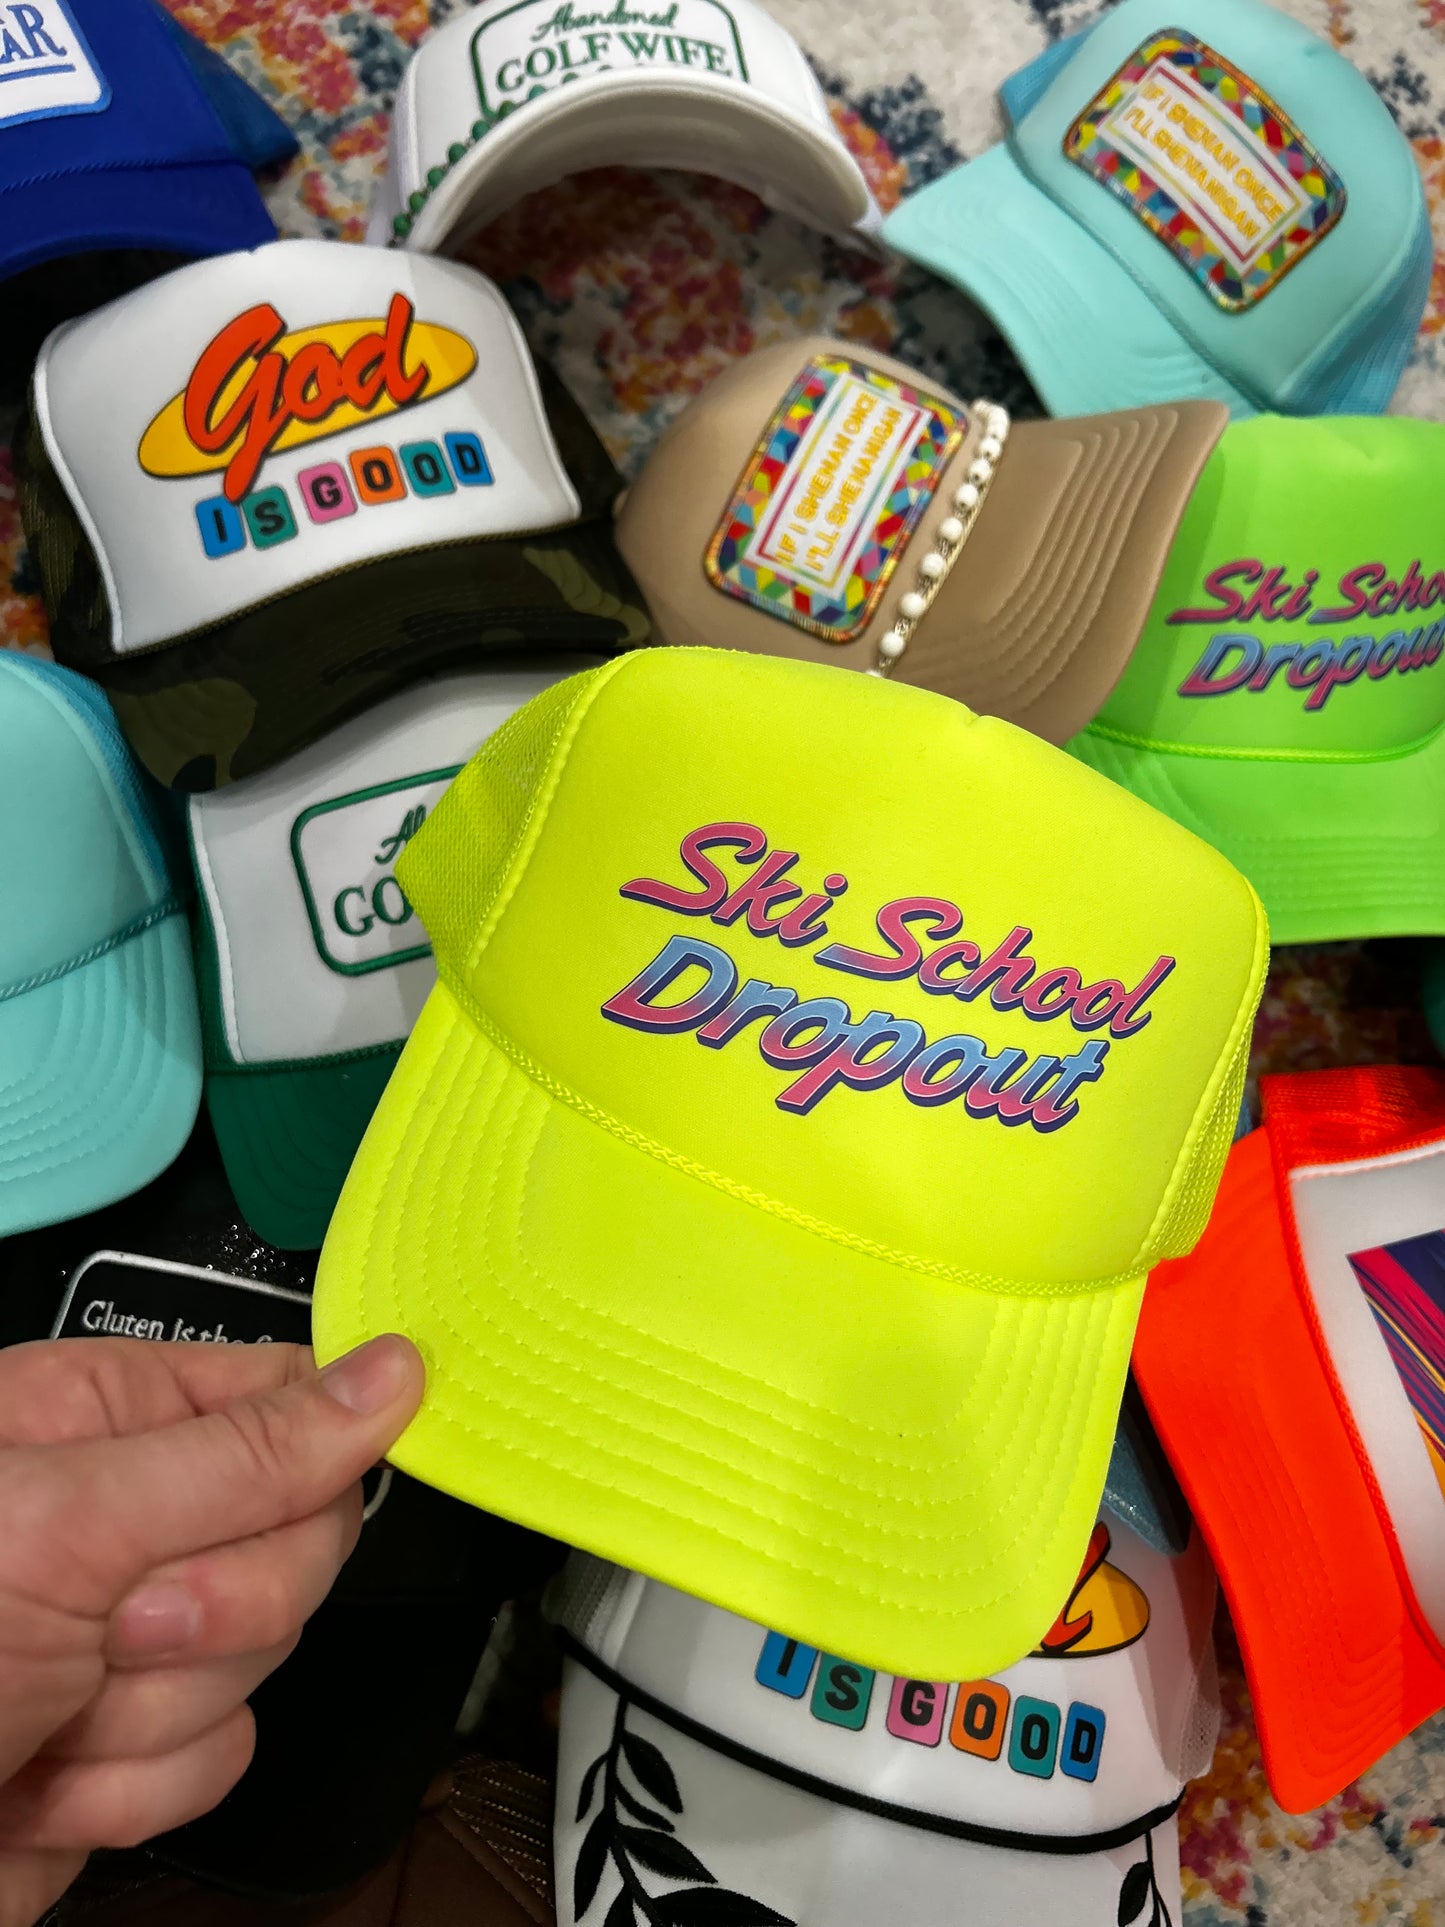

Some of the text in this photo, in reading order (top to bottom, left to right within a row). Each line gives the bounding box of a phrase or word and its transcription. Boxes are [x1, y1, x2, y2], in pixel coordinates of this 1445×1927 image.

[531, 0, 680, 42] Abandoned
[496, 32, 733, 92] GOLF WIFE
[1233, 166, 1286, 224] ONCE
[184, 292, 432, 505] God
[211, 443, 482, 544] IS GOOD
[794, 432, 854, 523] SHENAN
[805, 406, 904, 572] I'LL SHENANIGAN
[776, 533, 797, 563] IF
[789, 522, 808, 535] I
[1166, 558, 1445, 626] Ski Scho
[333, 876, 415, 937] GO
[619, 821, 1177, 1039] Ski School
[600, 933, 1110, 1134] Dropout
[81, 1299, 165, 1341] Gluten
[776, 1638, 1099, 1765] IS GOOD
